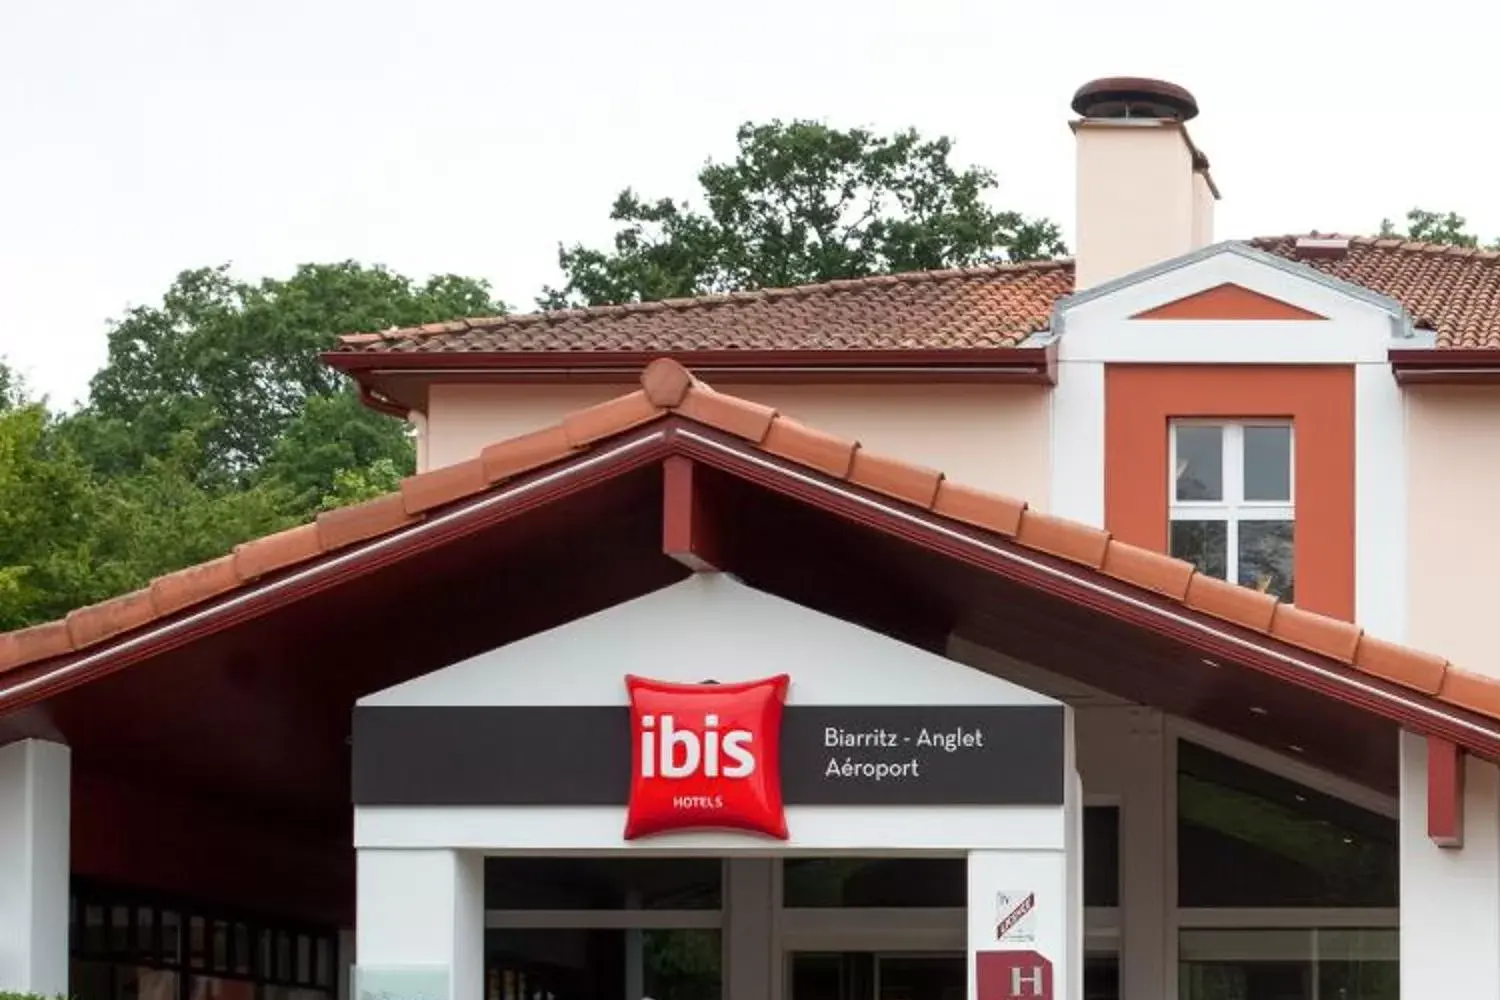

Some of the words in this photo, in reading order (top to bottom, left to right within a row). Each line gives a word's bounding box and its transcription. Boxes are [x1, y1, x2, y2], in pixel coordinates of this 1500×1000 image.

[641, 713, 756, 778] ibis
[824, 727, 898, 747] Biarritz
[917, 726, 984, 752] Anglet
[825, 756, 919, 781] Aéroport
[673, 795, 723, 808] HOTELS
[1008, 965, 1044, 997] H
